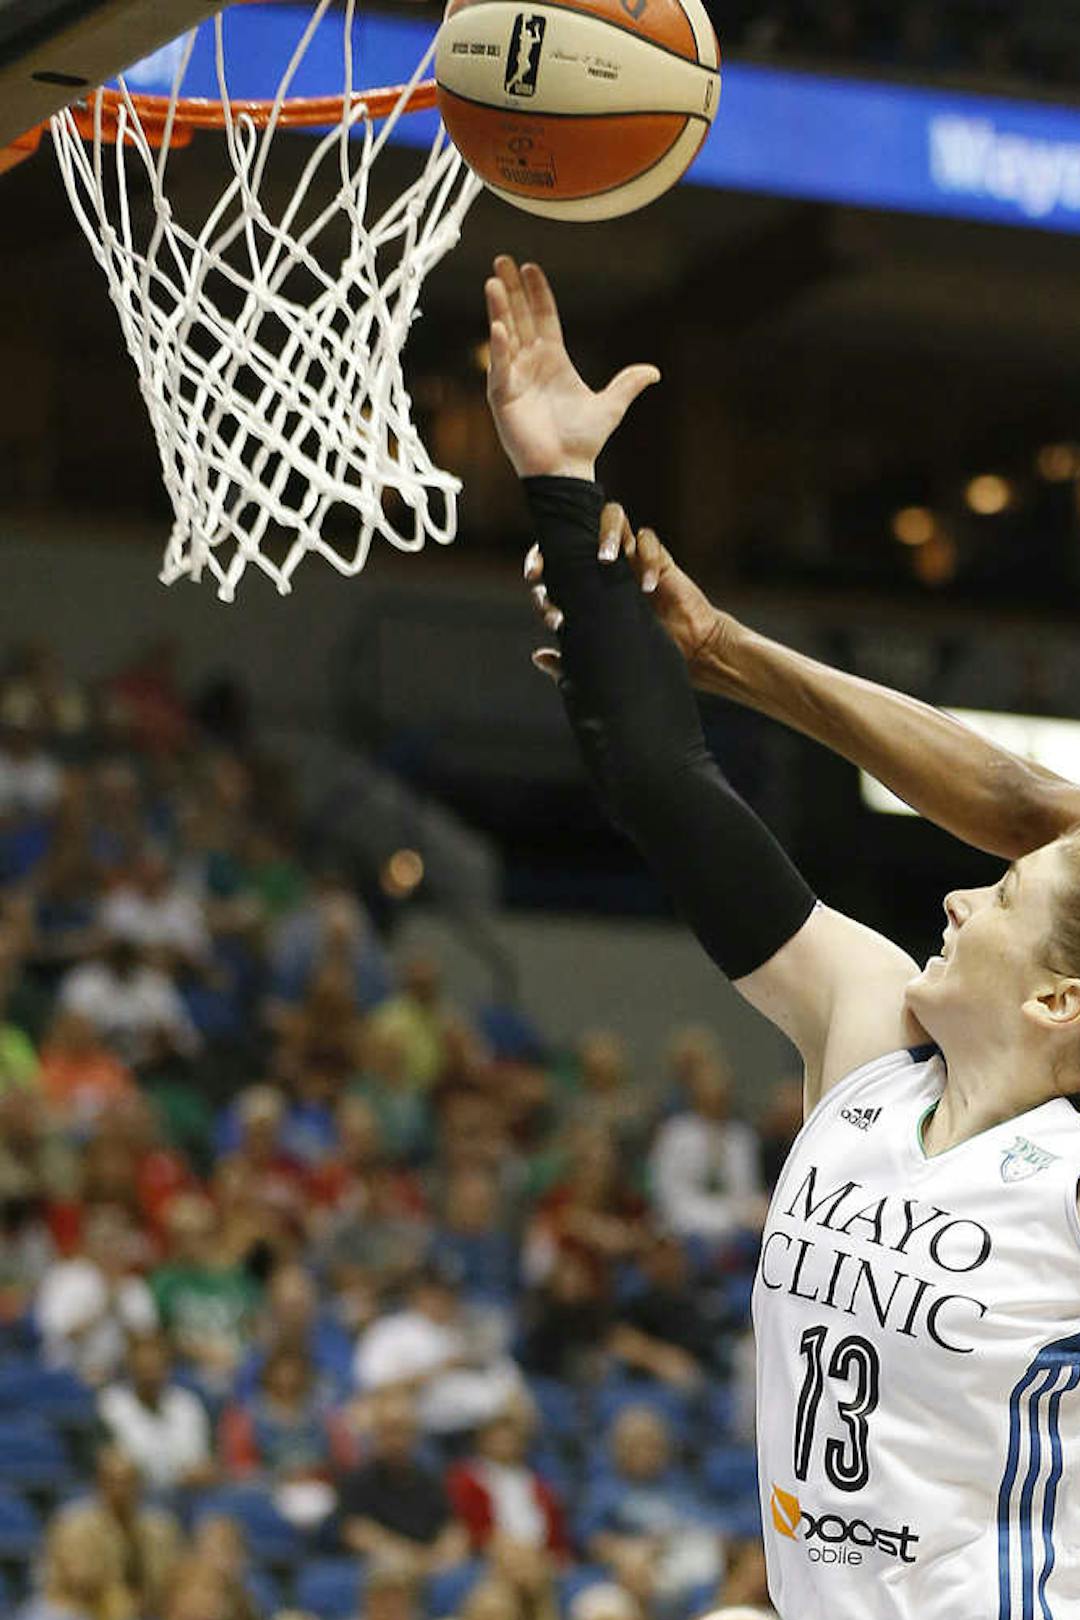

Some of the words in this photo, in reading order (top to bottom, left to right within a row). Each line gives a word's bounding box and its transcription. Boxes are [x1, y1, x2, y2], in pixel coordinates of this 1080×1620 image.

[783, 1166, 991, 1272] MAYO
[760, 1231, 989, 1353] CLINIC
[794, 1325, 880, 1493] 13
[807, 1545, 863, 1566] obile
